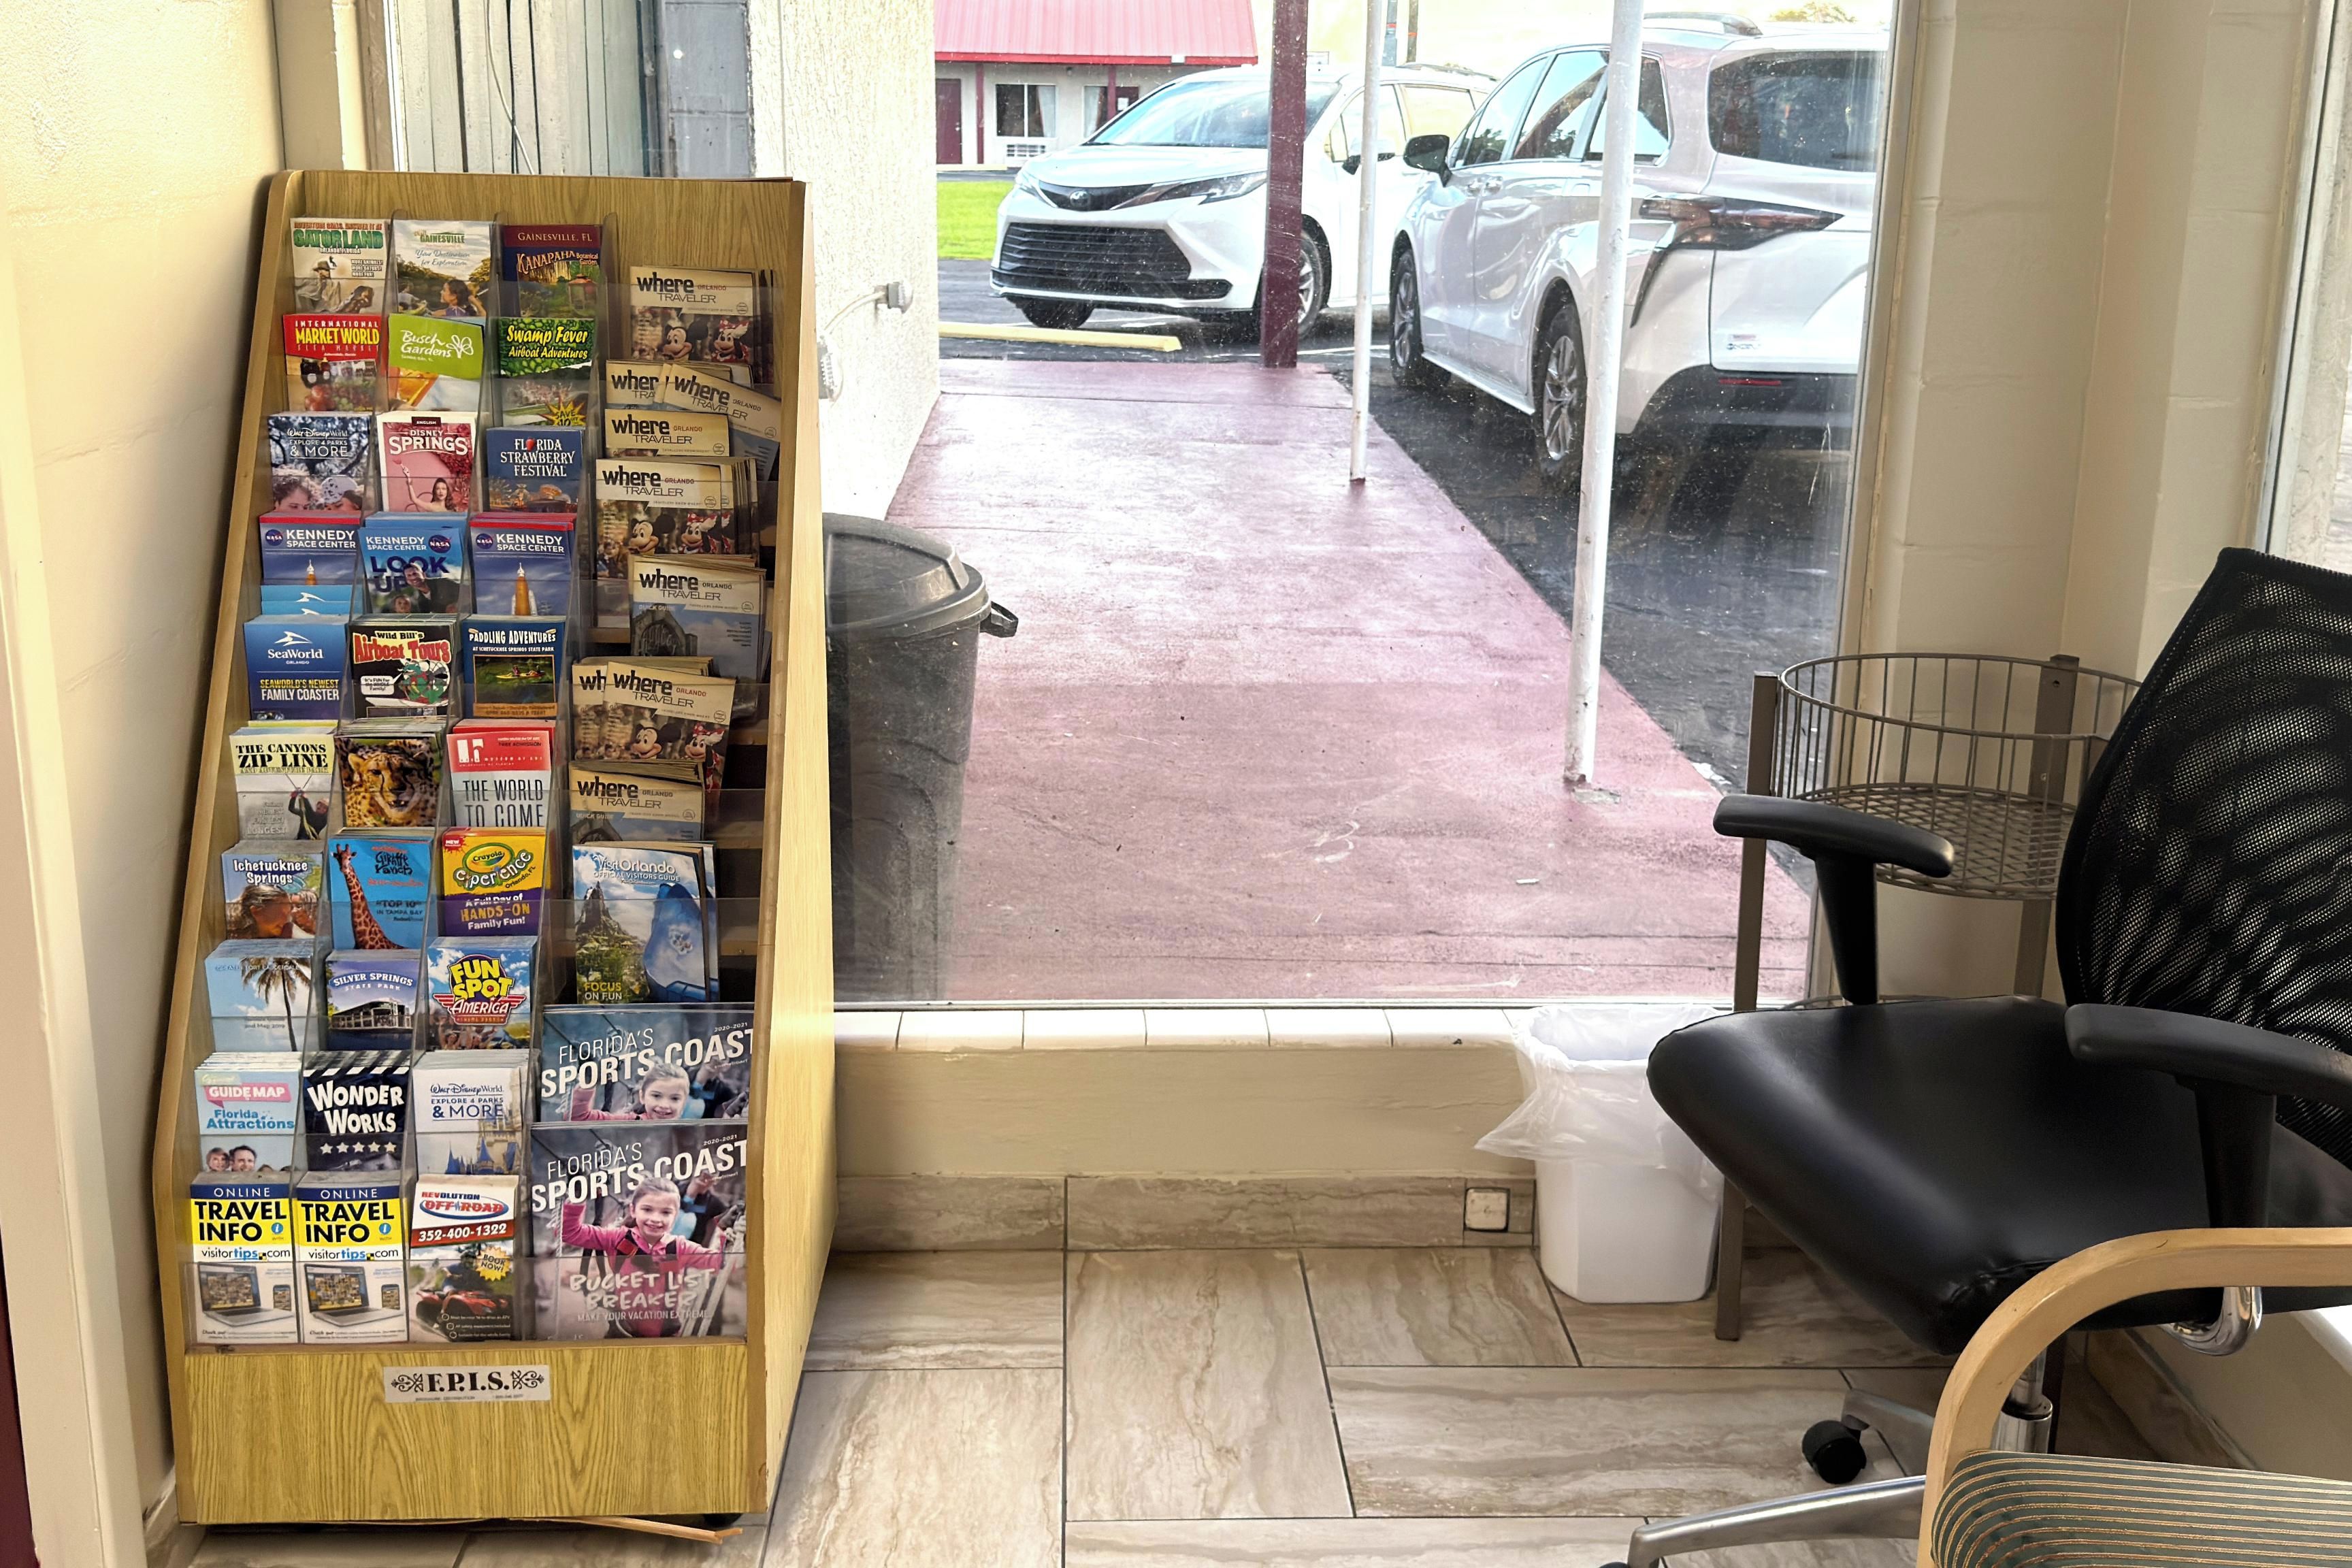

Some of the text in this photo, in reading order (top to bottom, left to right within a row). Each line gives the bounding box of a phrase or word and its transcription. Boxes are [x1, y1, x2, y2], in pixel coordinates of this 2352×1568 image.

[293, 229, 384, 249] GATORLAND
[420, 234, 466, 244] GAINESVILLE
[583, 233, 593, 245] FL
[415, 249, 471, 259] Your Destination
[432, 258, 468, 266] Exploration
[517, 249, 576, 274] KANAPAHA
[636, 271, 695, 294] where
[657, 292, 717, 304] TRAVELER
[295, 319, 379, 331] INTERNATIONAL
[295, 330, 380, 346] MARKET WORLD
[400, 329, 446, 350] Busch
[506, 325, 589, 346] Swamp Fever
[400, 342, 453, 361] Gardens
[508, 346, 589, 360] Airboat Adventures
[674, 374, 731, 410] where
[732, 399, 762, 412] ORLANDO
[611, 413, 670, 436] where
[673, 427, 703, 436] ORLANDO
[302, 427, 331, 440] Disney
[632, 434, 693, 445] TRAVELER
[289, 446, 349, 457] & MORE
[388, 436, 469, 456] SPRINGS
[500, 450, 576, 464] STRAWBERRY
[514, 463, 567, 477] FESTIVAL
[602, 464, 662, 487] where
[664, 477, 695, 485] ORLANDO
[622, 485, 684, 497] TRAVELER
[265, 534, 283, 543] NASA
[286, 529, 355, 541] KENNEDY
[365, 536, 425, 545] KENNEDY
[495, 533, 564, 546] KENNEDY
[286, 540, 357, 549] SPACE CENTER
[497, 544, 566, 553] SPACE CENTER
[370, 555, 451, 574] LOOK
[373, 575, 410, 593] UP
[639, 568, 699, 591] where
[702, 582, 733, 590] ORLANDO
[659, 589, 721, 602] TRAVELER
[376, 632, 424, 640] Wild Bill's
[469, 630, 557, 644] PADDLING ADVENTURES
[267, 649, 324, 659] SeaWorld
[353, 632, 452, 664] Airboat Tours
[260, 679, 340, 689] SEAWORLD'S NEWEST
[613, 670, 673, 696] where
[261, 688, 340, 701] FAMILY COASTER
[632, 690, 695, 708] TRAVELER
[676, 687, 707, 698] ORLANDO
[236, 743, 327, 754] THE CANYONS
[238, 753, 329, 768] ZIP LINE
[462, 779, 544, 802] THE WORLD
[577, 775, 639, 799] where
[642, 790, 674, 798] ORLANDO
[598, 796, 662, 809] TRAVELER
[465, 803, 545, 828] TO COME
[472, 850, 505, 863] Crayola
[233, 859, 309, 872] Ichetucknee
[593, 853, 676, 875] Visit Orlando
[246, 871, 293, 886] Springs
[593, 871, 625, 879] OFFICIAL
[626, 872, 657, 881] VISITORS
[658, 874, 681, 882] GUIDE
[465, 892, 523, 908] A Full Day of
[460, 902, 531, 923] HANDS-ON
[468, 916, 526, 931] Family Fun!
[449, 958, 501, 985] FUN
[333, 972, 414, 987] SILVER SPRINGS
[344, 983, 401, 992] STATE PARK
[455, 977, 514, 1002] SPOT
[583, 981, 622, 993] FOCUS
[585, 991, 623, 1001] ON FUN
[449, 999, 510, 1015] AMERICA
[559, 1028, 655, 1065] FLORIDA'S
[540, 1047, 656, 1098] SPORTS
[208, 1085, 286, 1098] GUIDE MAP
[306, 1079, 405, 1113] WONDER
[448, 1082, 502, 1096] Disney World
[430, 1097, 468, 1105] EXPLORE
[214, 1109, 259, 1120] Florida
[431, 1103, 504, 1119] & MORE
[206, 1116, 296, 1130] Attractions
[323, 1108, 397, 1137] WORKS
[546, 1141, 643, 1180] FLORIDA'S
[531, 1139, 749, 1213] SPORTS COAST
[213, 1186, 271, 1198] ONLINE
[319, 1188, 378, 1200] ONLINE
[421, 1191, 480, 1201] REVOLUTION
[193, 1200, 288, 1221] TRAVEL
[300, 1201, 395, 1223] TRAVEL
[459, 1200, 506, 1215] ROAD
[198, 1221, 263, 1242] INFO
[306, 1223, 371, 1244] INFO
[418, 1222, 508, 1243] 352-400-1322
[201, 1246, 291, 1263] visitortips.com
[308, 1247, 399, 1263] visitortips.com
[483, 1253, 507, 1267] BOOK
[480, 1262, 505, 1274] NOW!
[569, 1267, 716, 1292] BUCKET LIST
[584, 1290, 699, 1311] BREAKER
[604, 1311, 668, 1321] YOUR VACATION
[424, 1371, 510, 1392] F.P.I.S.
